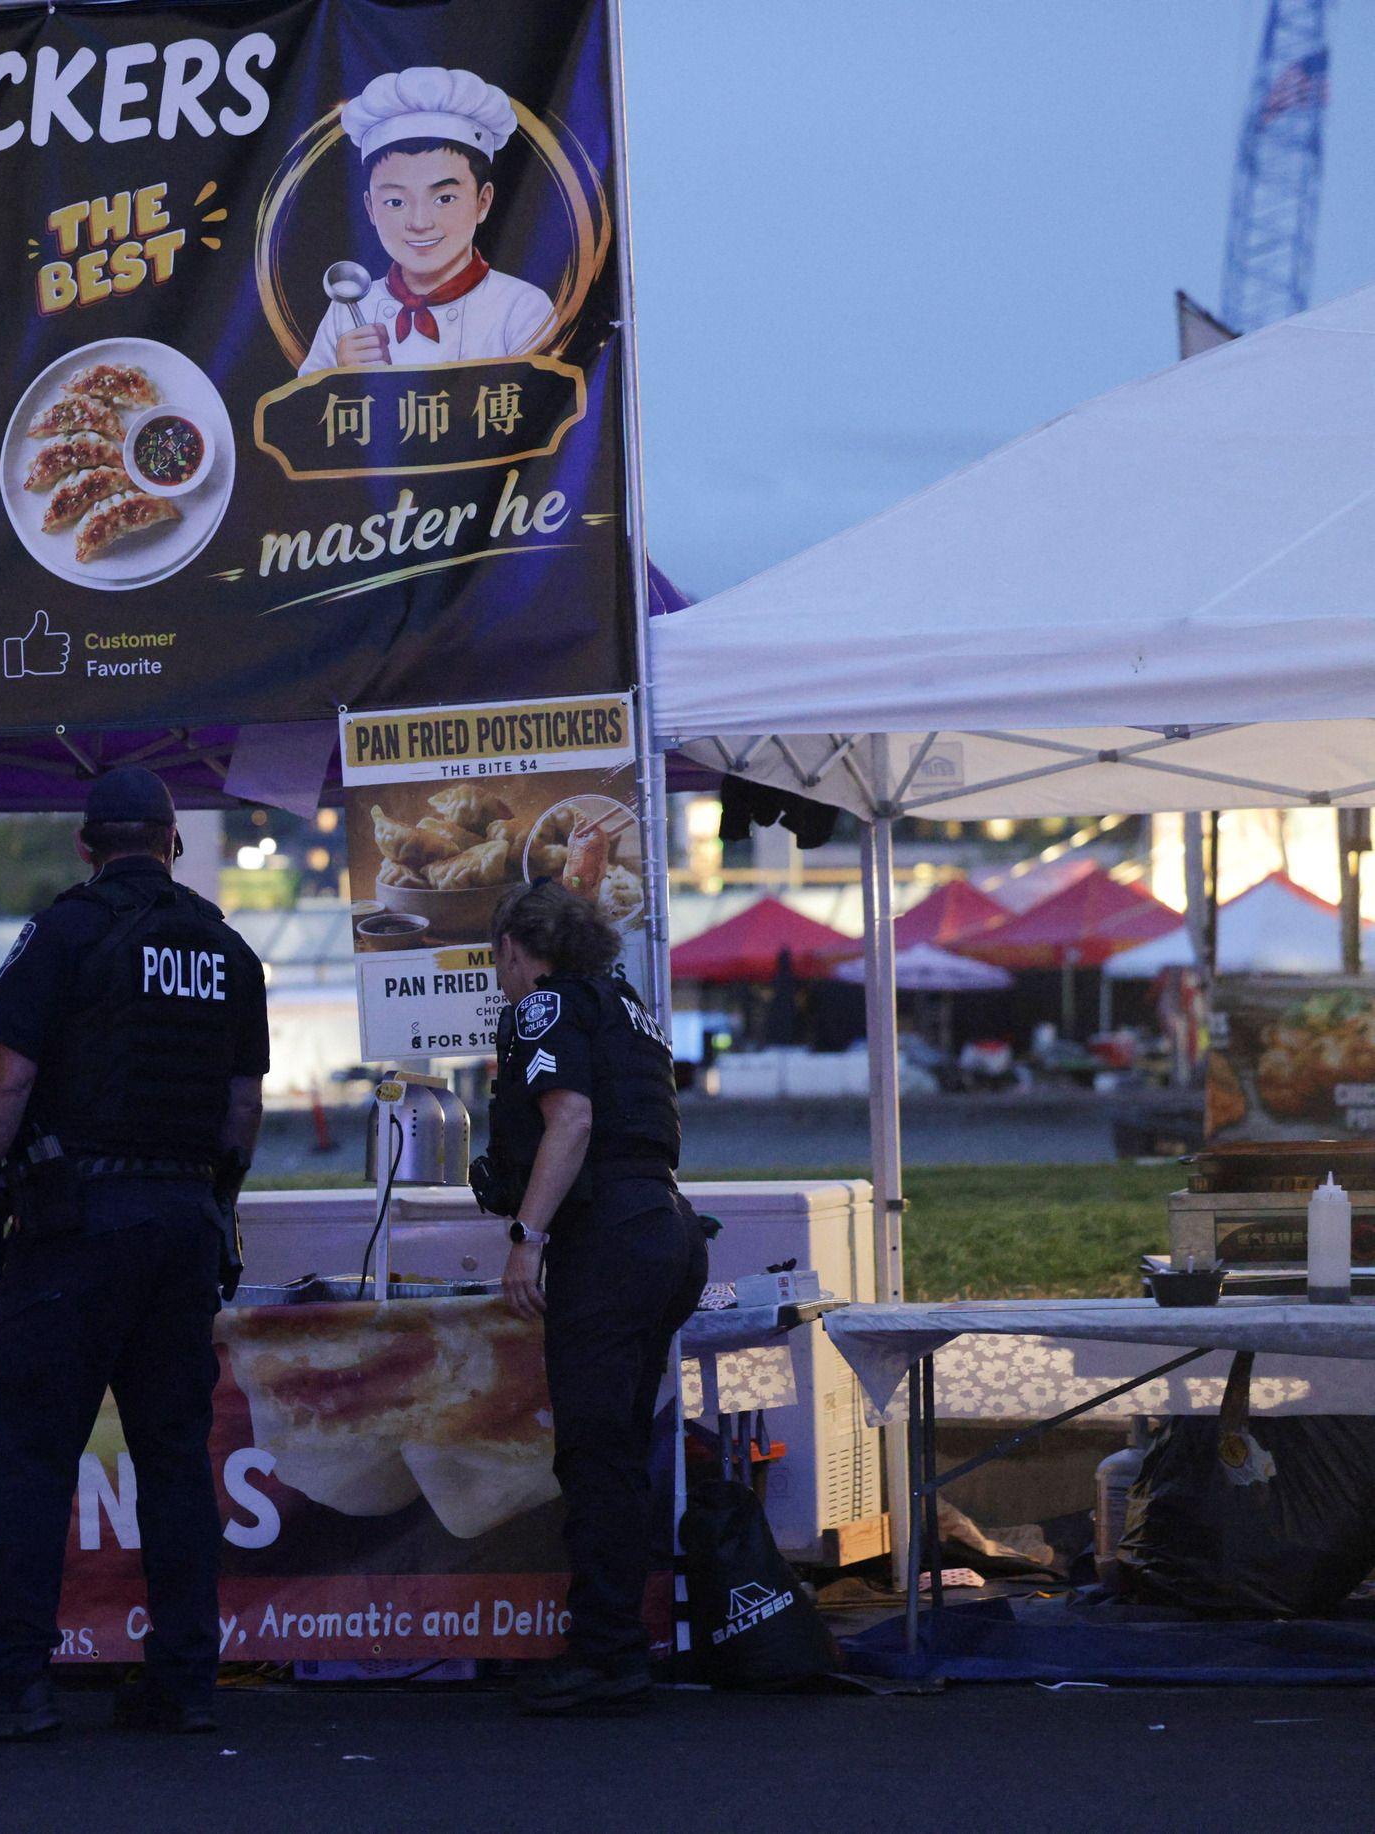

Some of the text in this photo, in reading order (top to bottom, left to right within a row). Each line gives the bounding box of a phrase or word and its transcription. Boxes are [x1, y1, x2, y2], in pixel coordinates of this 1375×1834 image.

[47, 181, 171, 257] THE
[36, 228, 187, 315] BEST
[318, 383, 524, 448] 何师傅
[259, 468, 571, 577] master he
[84, 632, 177, 651] Customer
[87, 658, 163, 678] Favorite
[356, 707, 622, 762] PAN FRIED POTSTICKERS
[440, 759, 538, 777] THE BITE $4
[143, 946, 225, 1001] POLICE
[385, 976, 425, 997] PAN
[433, 972, 488, 994] FRIED
[476, 1007, 503, 1016] CHIC
[485, 996, 508, 1005] POR
[521, 994, 552, 1012] SEATTLE
[525, 1018, 548, 1035] POLICE
[428, 1035, 462, 1048] FOR
[469, 1032, 497, 1046] $18
[257, 1601, 413, 1639] Aromatic
[422, 1601, 480, 1638] and
[492, 1599, 572, 1636] Delic
